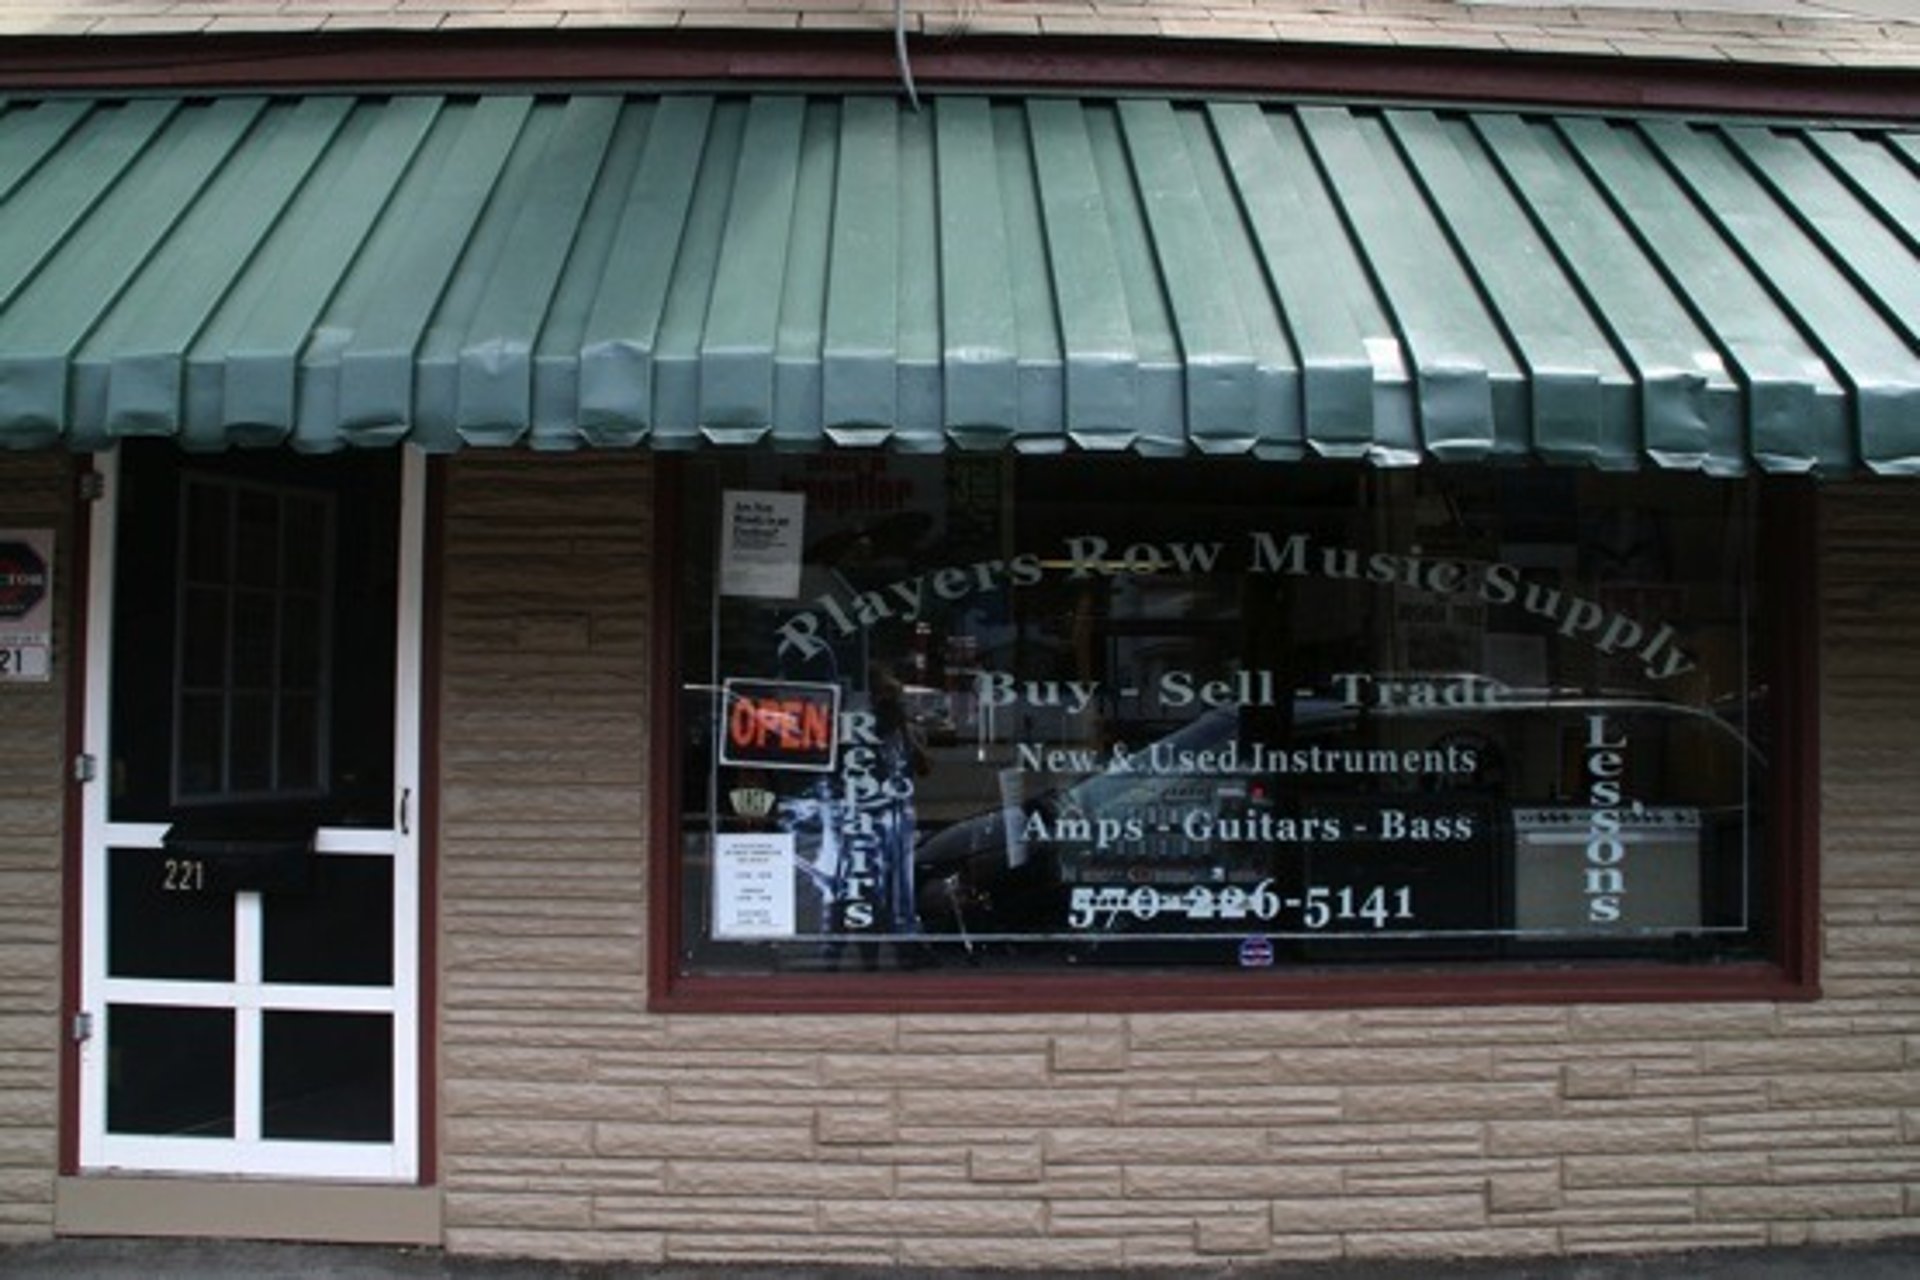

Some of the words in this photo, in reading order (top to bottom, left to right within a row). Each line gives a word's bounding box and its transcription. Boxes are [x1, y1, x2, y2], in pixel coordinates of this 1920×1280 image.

[776, 550, 1042, 661] Players
[1062, 534, 1222, 580] Row
[1249, 531, 1461, 594] Music
[1478, 563, 1696, 680] Supply
[976, 673, 1100, 715] Buy
[1160, 671, 1274, 706] Sell
[1332, 674, 1512, 709] Trade
[730, 698, 829, 751] OPEN
[1017, 745, 1096, 773] New
[1108, 745, 1140, 774] &
[1150, 741, 1238, 773] Used
[1250, 744, 1477, 773] Instruments
[840, 711, 884, 929] Repairs
[1020, 812, 1143, 848] Amps
[1183, 809, 1340, 841] Guitars
[1380, 811, 1472, 840] Bass
[1584, 715, 1627, 922] Lessons
[163, 859, 203, 890] 221
[1068, 877, 1414, 929] 570-226-5141
